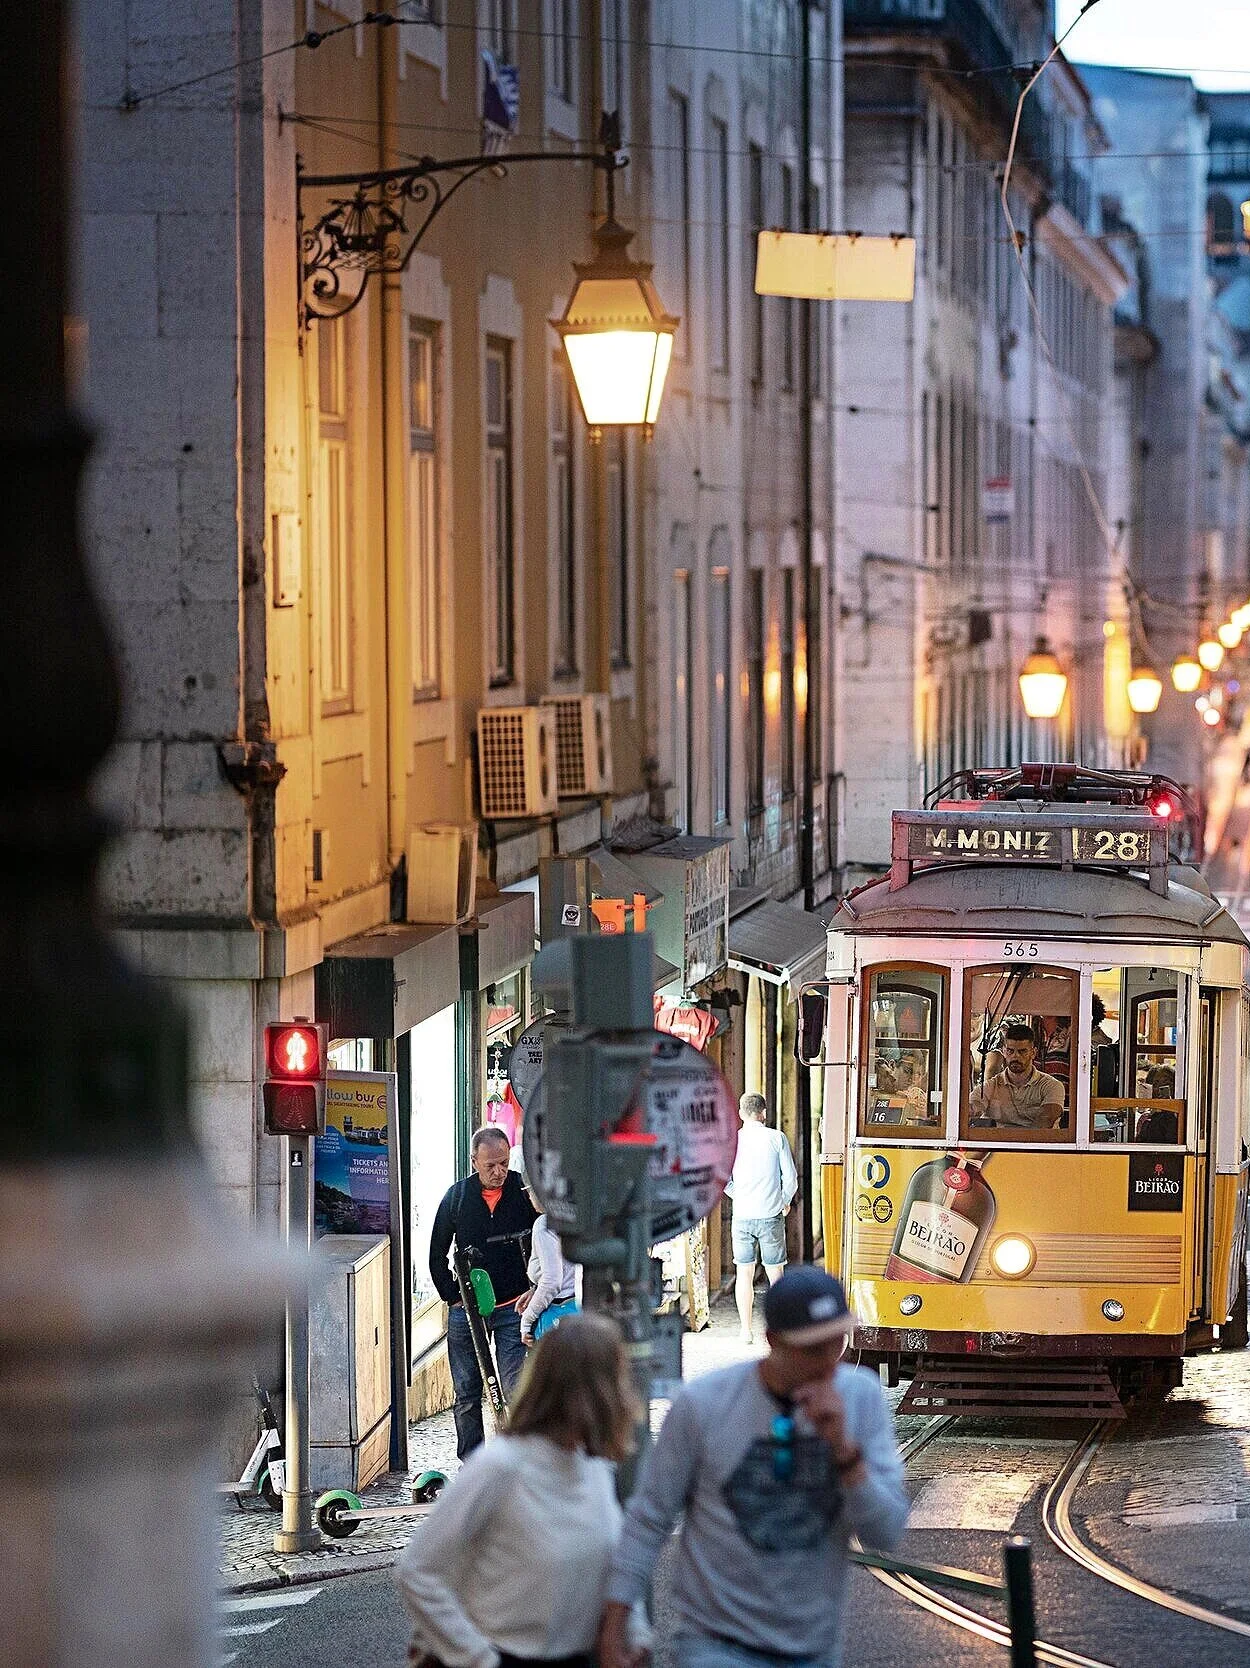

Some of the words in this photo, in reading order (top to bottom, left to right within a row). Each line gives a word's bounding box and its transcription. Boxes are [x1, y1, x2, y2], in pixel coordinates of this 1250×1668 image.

[1093, 830, 1139, 861] 28
[600, 922, 616, 932] 28E
[1003, 942, 1038, 957] 565
[355, 1090, 375, 1103] bus
[874, 1112, 886, 1122] 16
[353, 1159, 378, 1167] TICKETS
[349, 1167, 388, 1176] INFORMATIO
[1134, 1179, 1180, 1194] BEIRÃO
[909, 1219, 966, 1256] BEIRÃO
